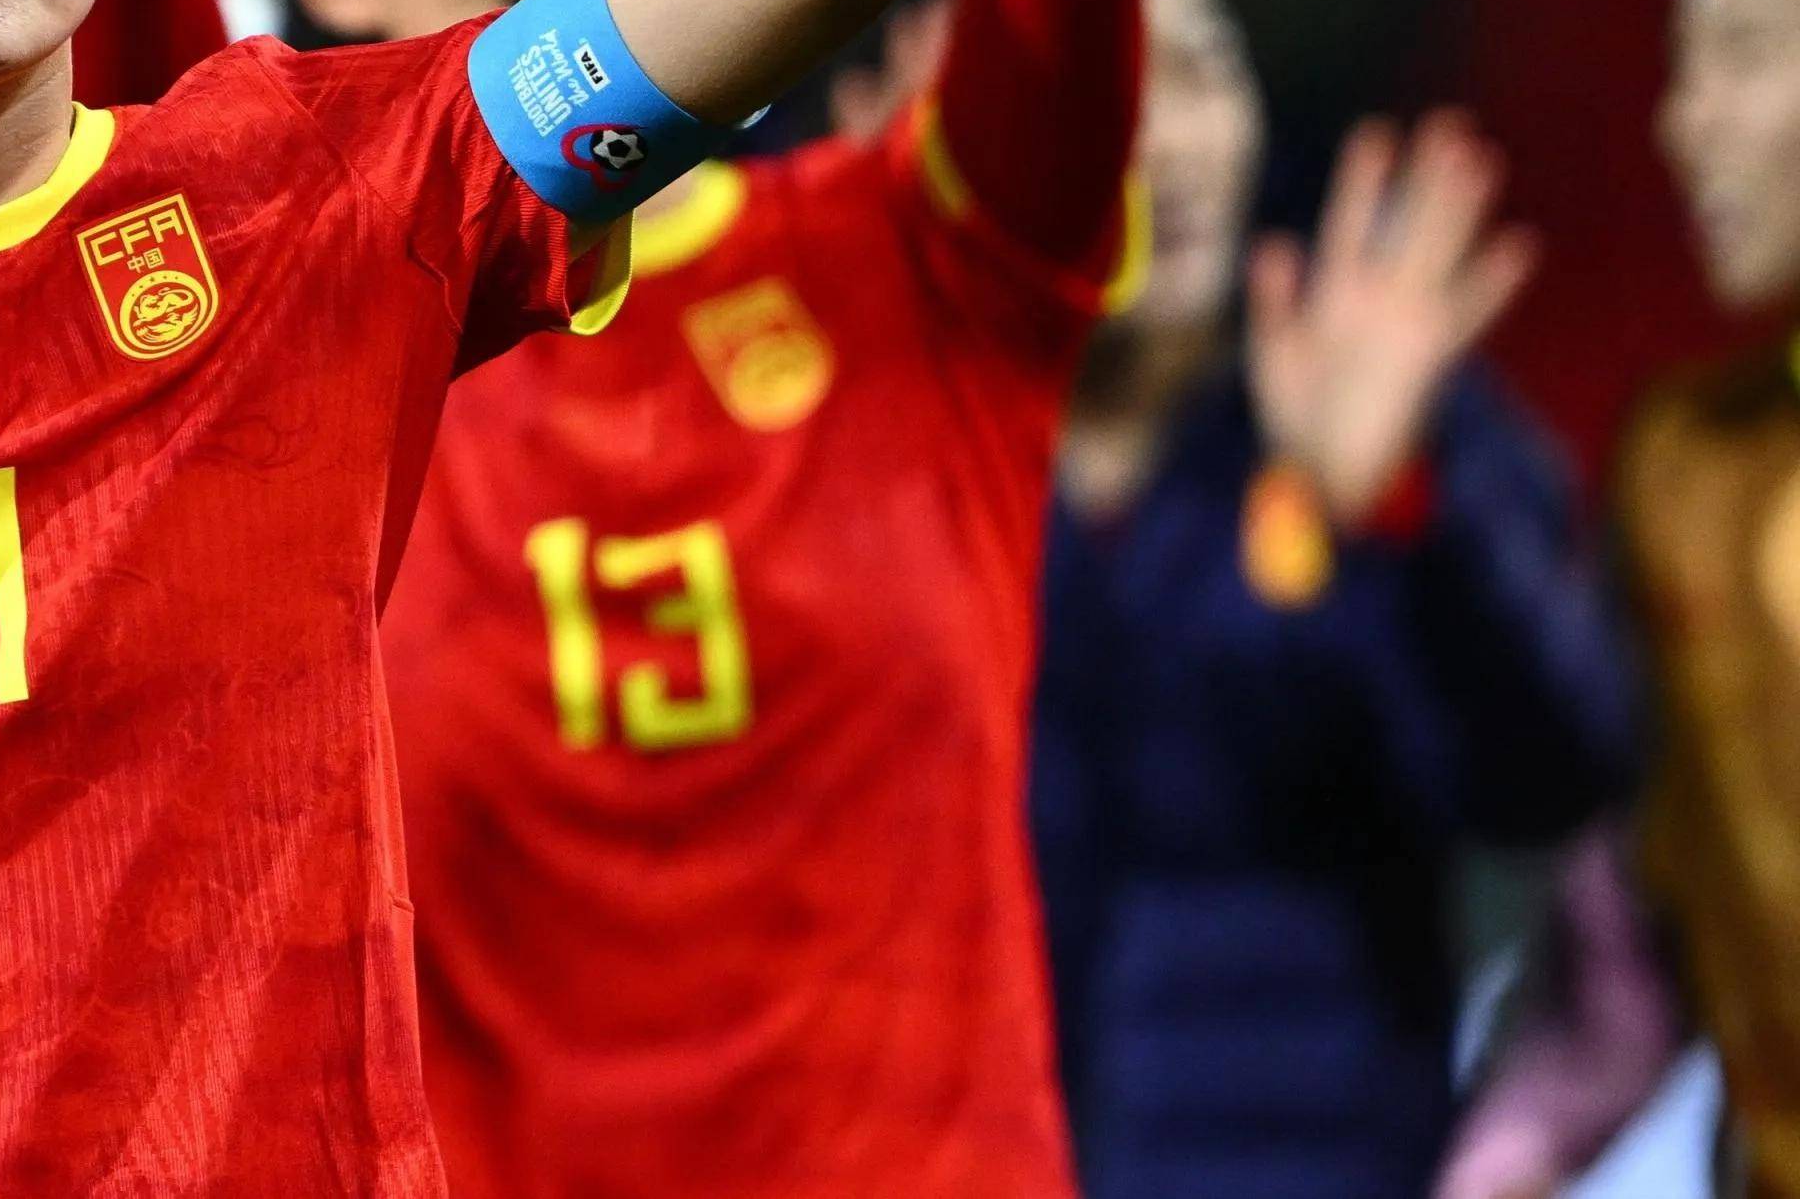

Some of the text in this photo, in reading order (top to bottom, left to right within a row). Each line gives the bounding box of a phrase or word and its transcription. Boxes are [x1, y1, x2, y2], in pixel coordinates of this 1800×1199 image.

[508, 58, 556, 138] FOOTBALL
[520, 45, 573, 125] UNITES
[539, 28, 590, 107] the World
[581, 50, 604, 85] FIFA
[89, 208, 185, 267] CFA
[126, 247, 165, 274] 中国
[525, 516, 751, 751] 13
